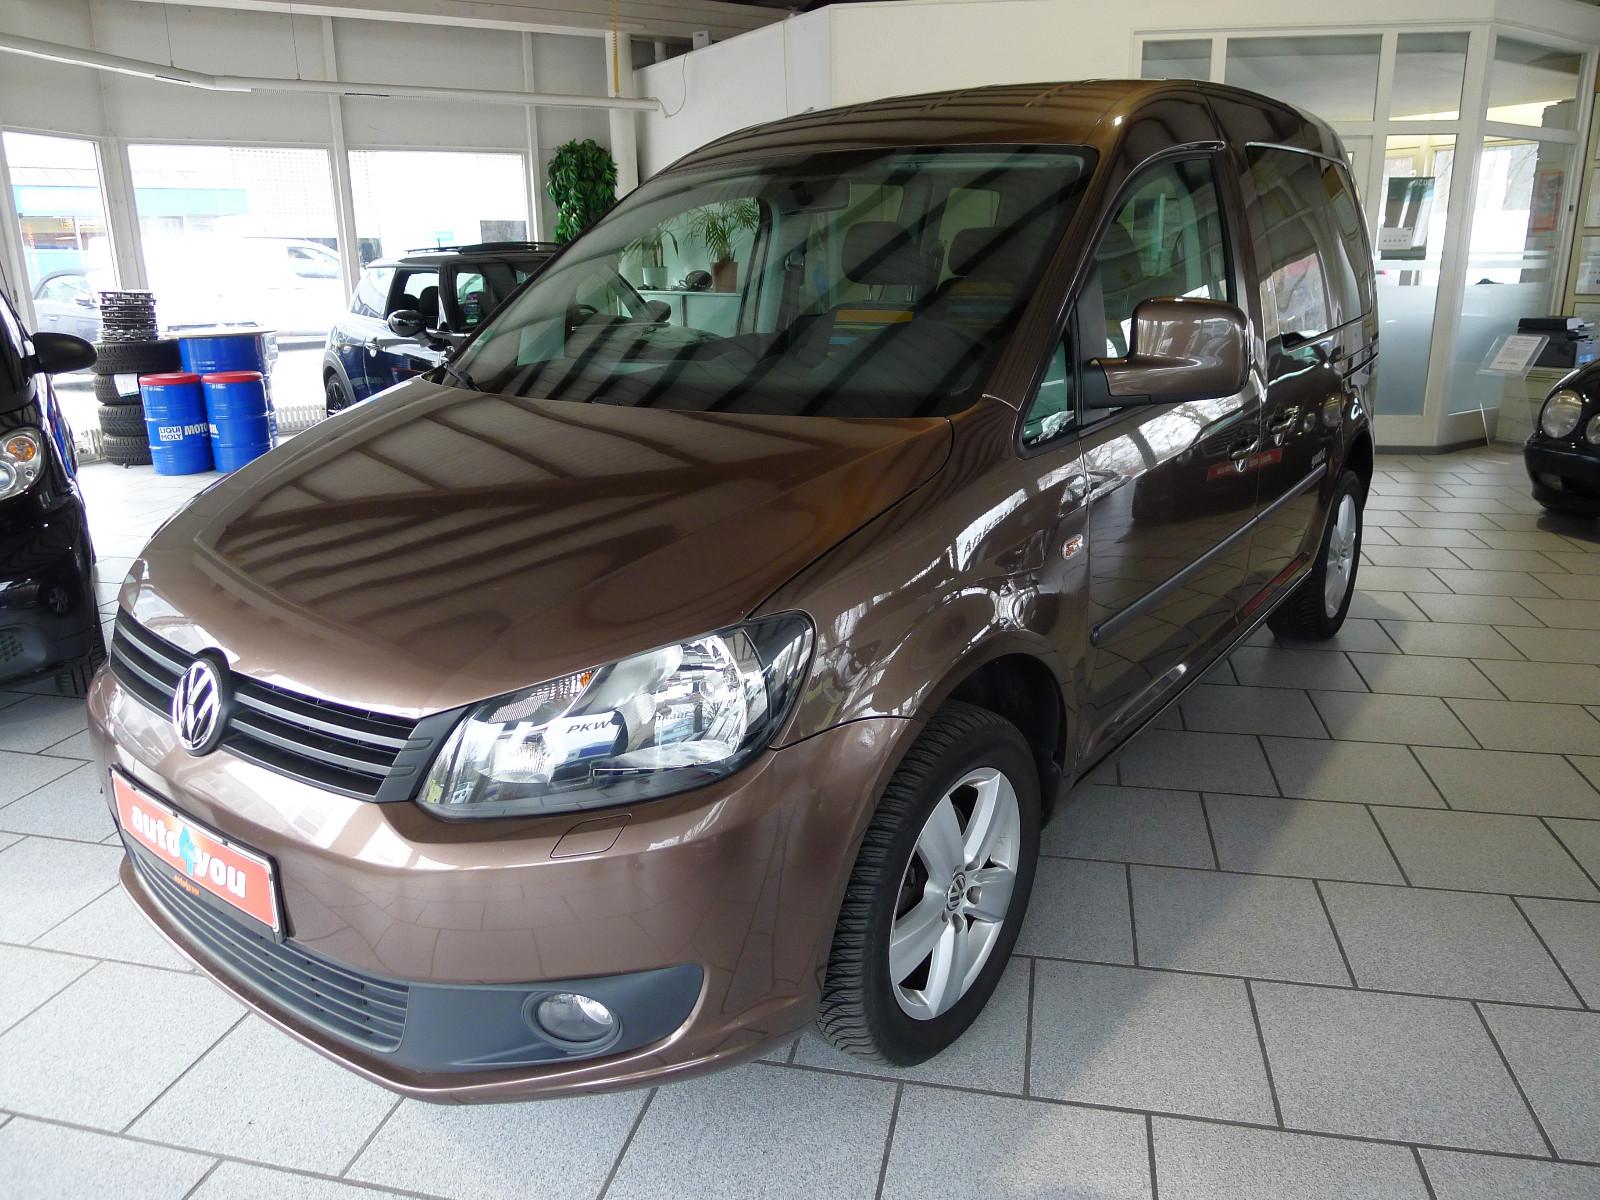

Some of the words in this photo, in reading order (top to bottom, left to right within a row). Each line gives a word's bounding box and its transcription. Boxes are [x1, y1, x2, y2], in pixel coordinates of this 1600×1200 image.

[159, 426, 181, 434] LIQUI
[160, 433, 182, 441] MOLY
[566, 720, 611, 734] PKW
